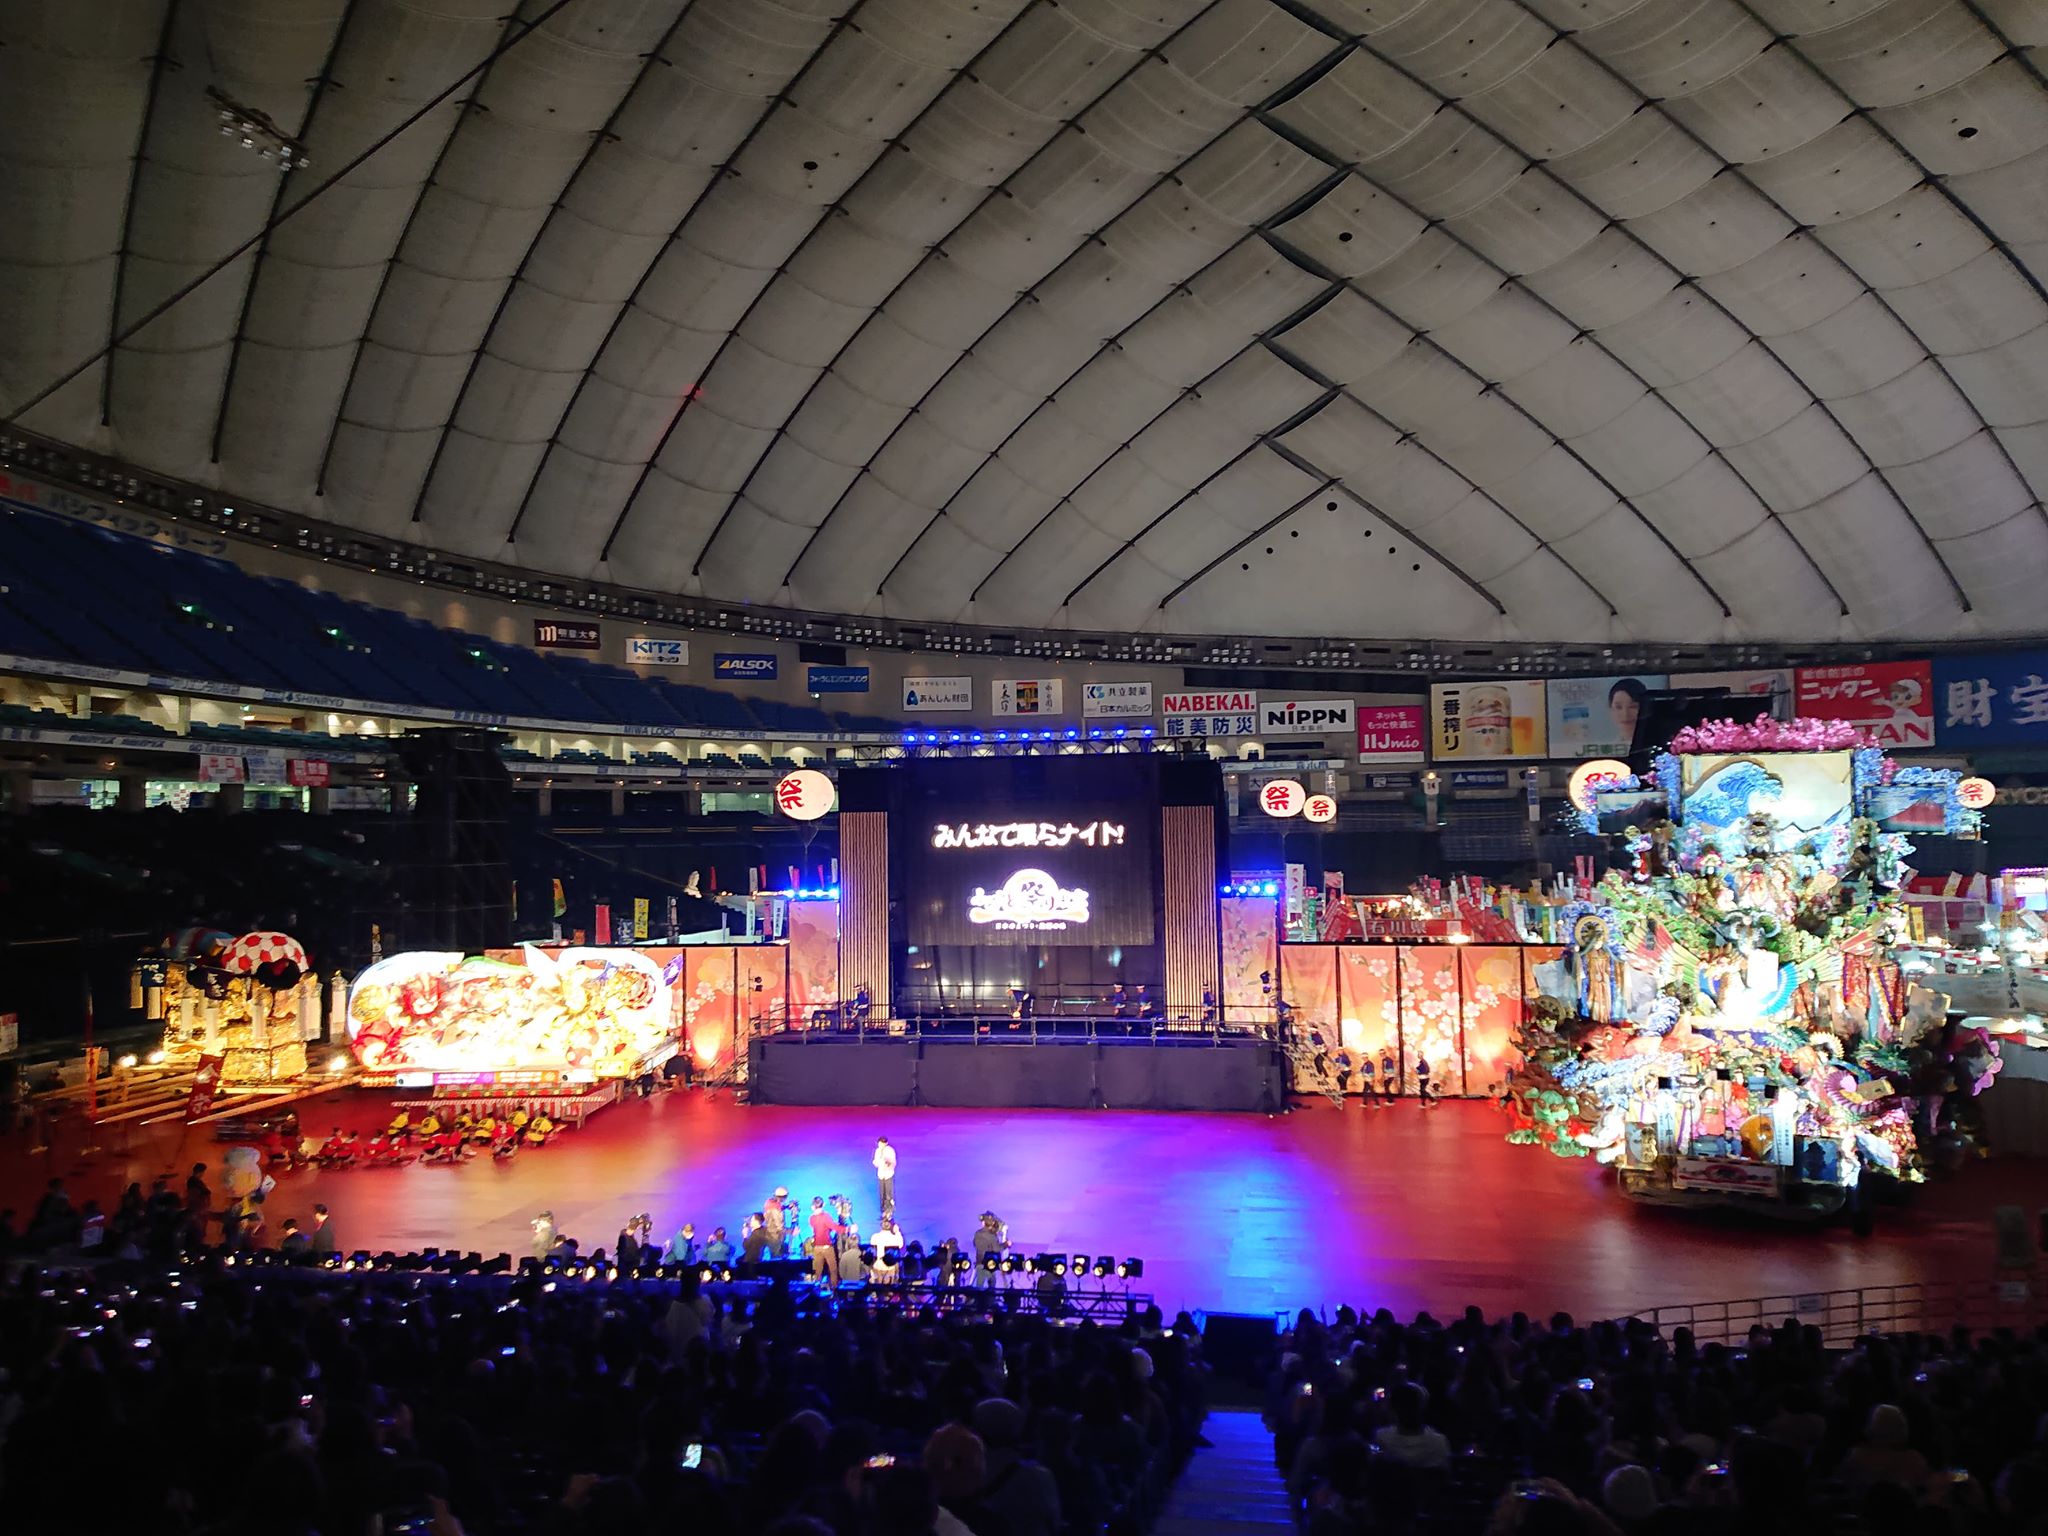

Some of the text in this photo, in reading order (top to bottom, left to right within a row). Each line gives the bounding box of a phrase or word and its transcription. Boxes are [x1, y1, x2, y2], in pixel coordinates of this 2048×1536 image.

[633, 640, 681, 655] KITZ
[730, 659, 774, 670] ALSOK
[1801, 679, 1881, 700] ニッタン
[294, 693, 344, 707] SHINRYO
[920, 694, 969, 703] あんしん財団
[1375, 711, 1407, 720] ネットを
[1443, 690, 1461, 751] 一番搾り
[624, 725, 677, 736] MIWA LOCK
[1167, 717, 1254, 736] 能美防災
[1364, 733, 1420, 750] IIJmio
[780, 779, 804, 810] 祭
[1266, 786, 1290, 811] 祭
[1312, 800, 1330, 817] 祭
